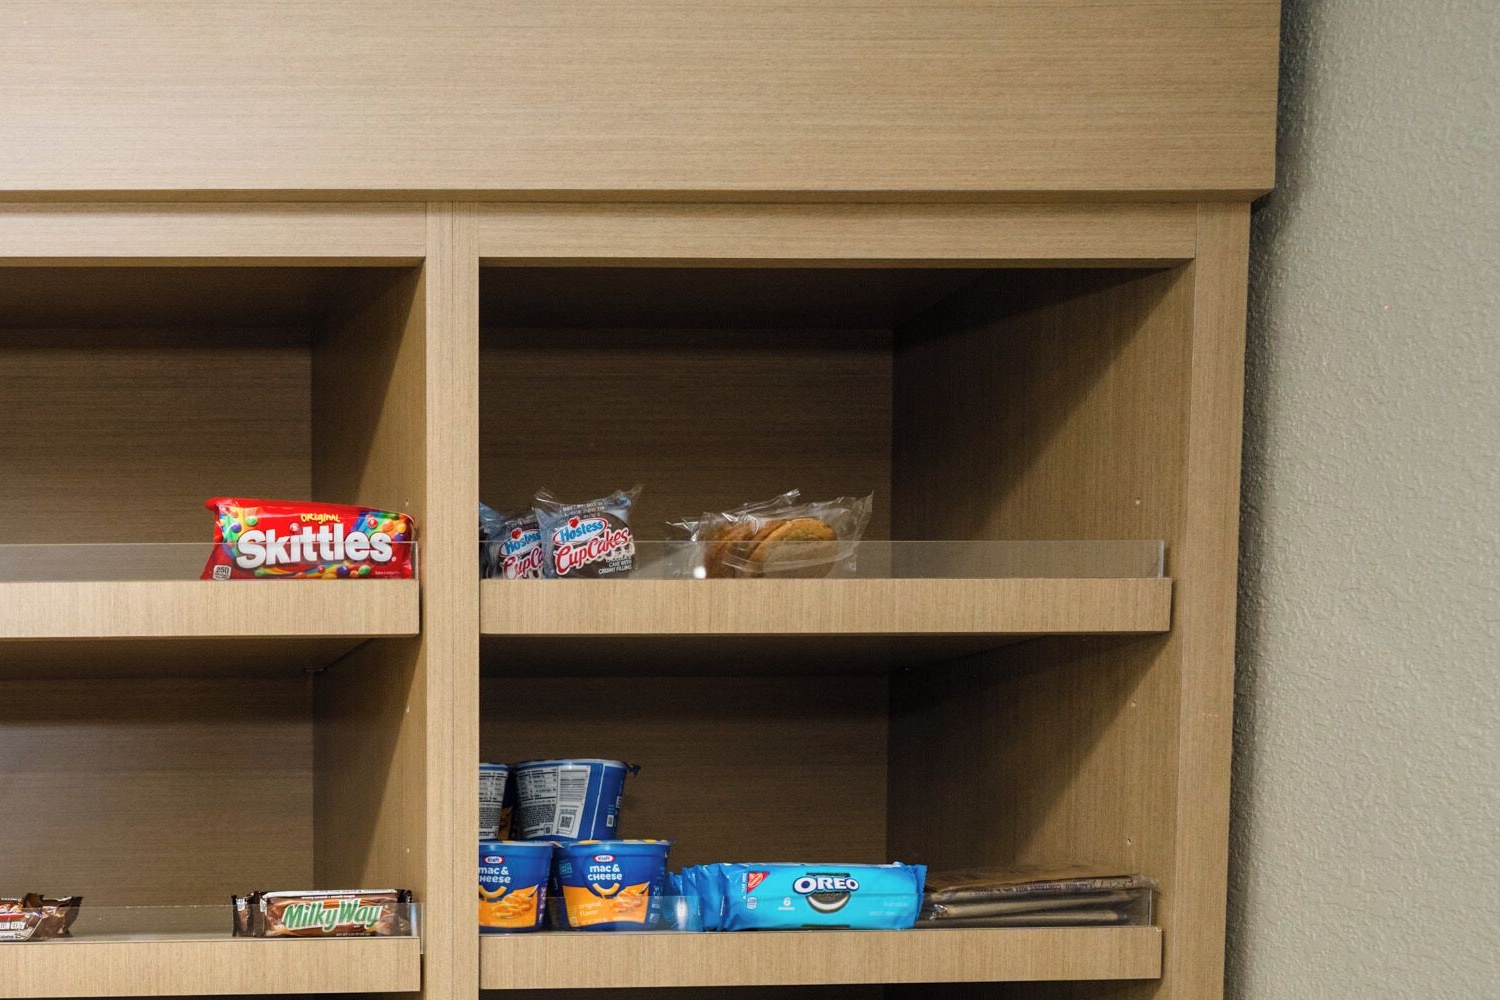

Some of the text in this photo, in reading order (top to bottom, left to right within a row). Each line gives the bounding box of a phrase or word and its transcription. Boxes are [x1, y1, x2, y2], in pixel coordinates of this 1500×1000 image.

[560, 519, 605, 543] Hostess
[235, 523, 393, 569] Skittles
[555, 528, 630, 576] CupCakes
[501, 865, 510, 876] &
[589, 864, 621, 874] mac &
[793, 875, 860, 893] OREO
